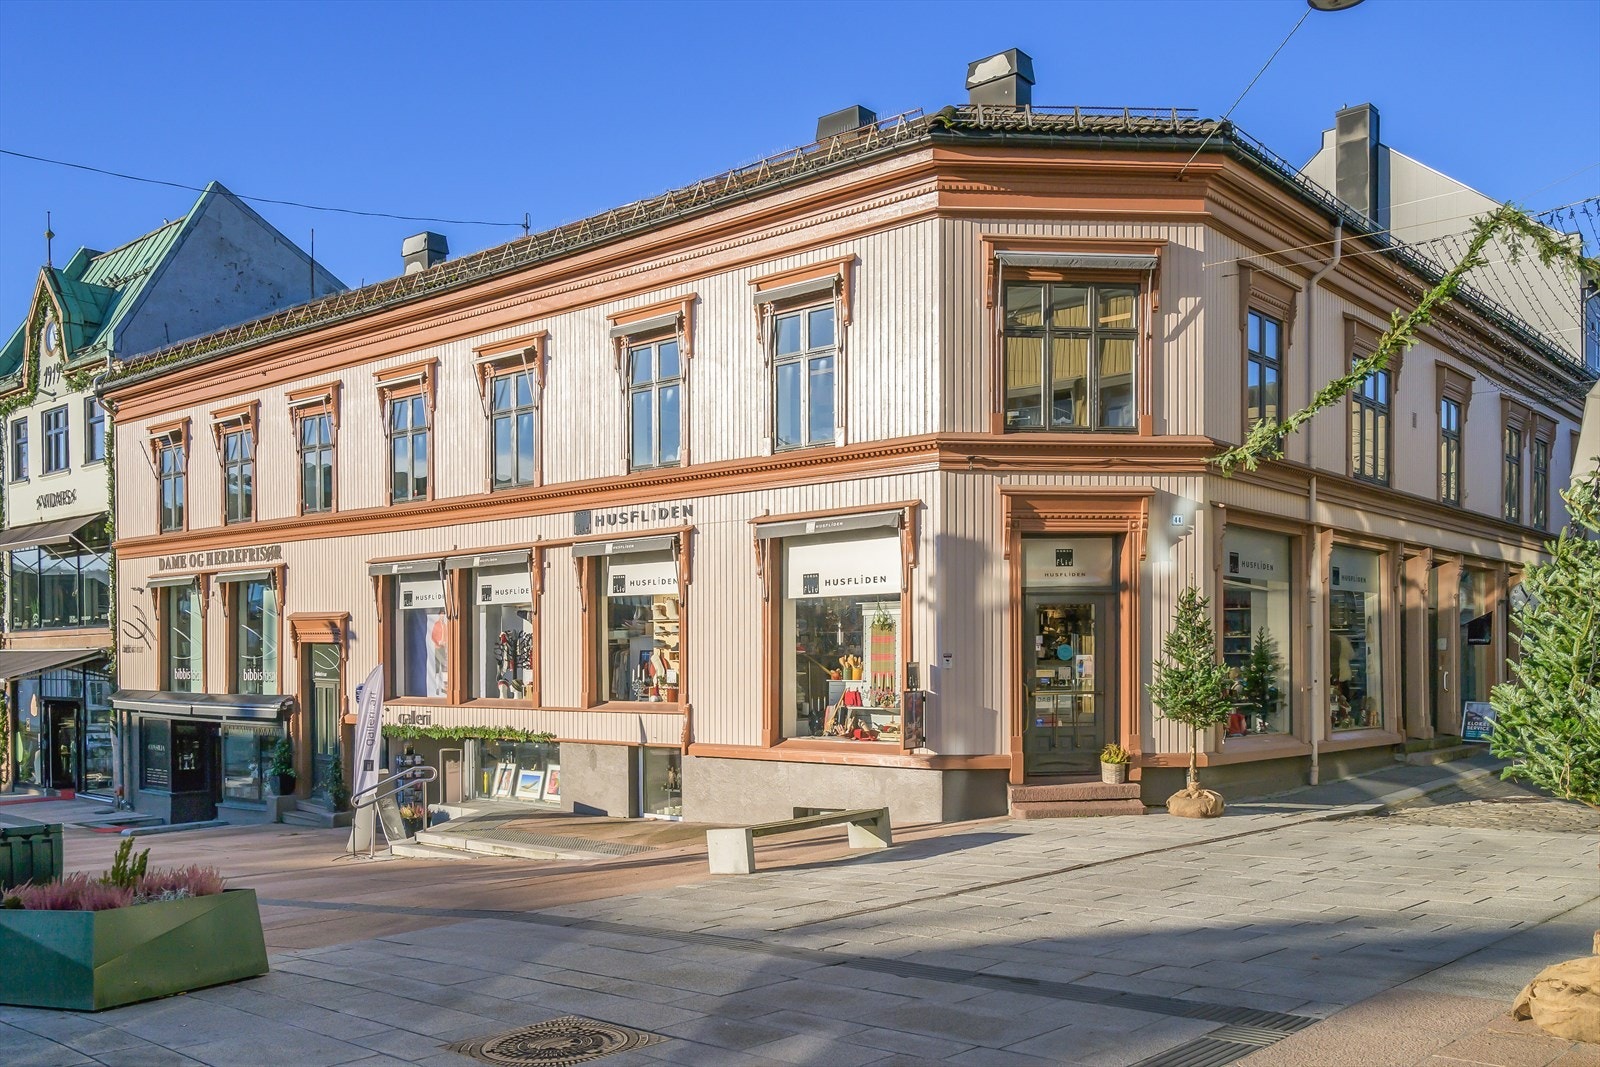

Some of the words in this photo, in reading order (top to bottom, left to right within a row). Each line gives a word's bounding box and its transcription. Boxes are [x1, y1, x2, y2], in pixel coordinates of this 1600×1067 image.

[44, 361, 61, 388] 1919
[1173, 516, 1182, 524] 44
[158, 555, 187, 571] DAME
[189, 553, 204, 568] OG
[206, 545, 282, 566] HERREFRISØR
[495, 586, 530, 596] HUSFLiDE
